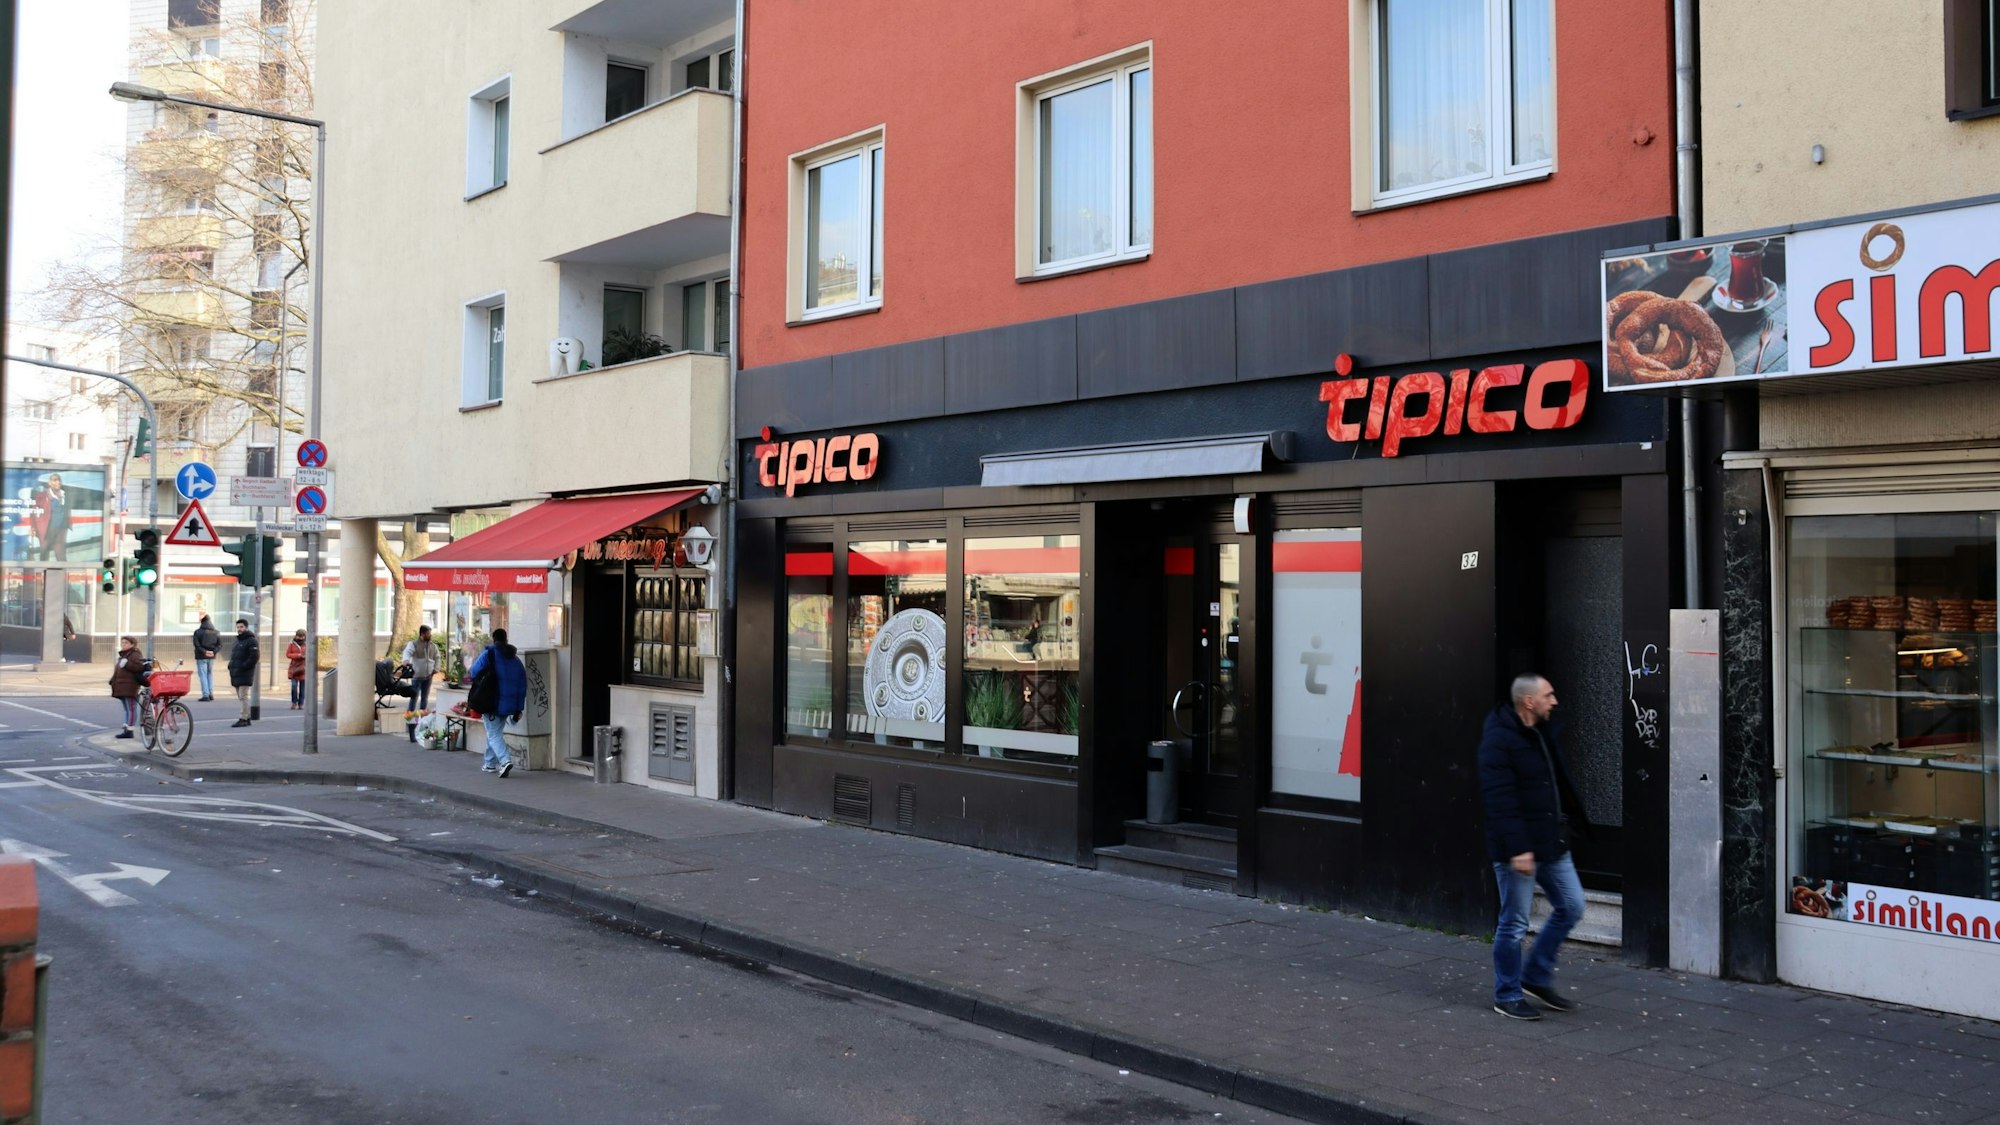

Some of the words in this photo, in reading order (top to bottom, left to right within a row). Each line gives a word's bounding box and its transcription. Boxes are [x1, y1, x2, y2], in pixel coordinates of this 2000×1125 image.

[1318, 353, 1590, 458] tipico
[754, 425, 879, 497] tipico
[1463, 553, 1477, 568] 32
